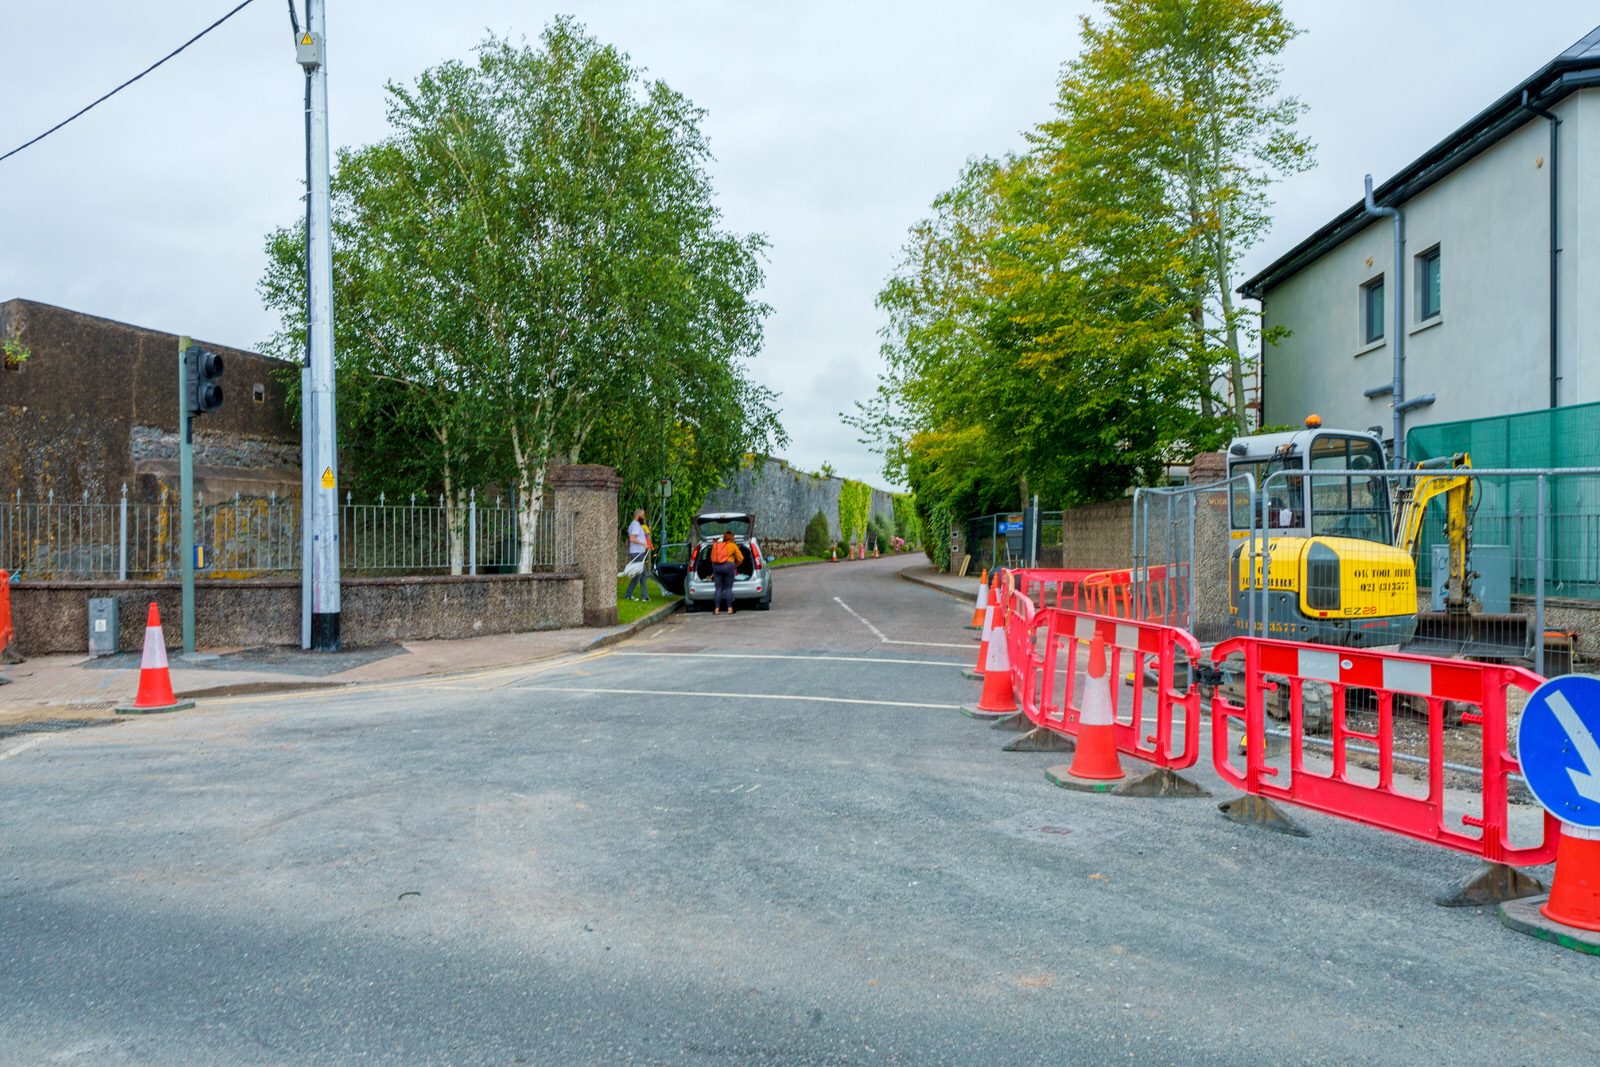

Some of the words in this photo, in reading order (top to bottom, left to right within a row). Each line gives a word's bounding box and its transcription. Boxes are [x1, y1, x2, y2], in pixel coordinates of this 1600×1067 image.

[1354, 569, 1368, 578] OK
[1372, 569, 1391, 578] TOOL
[1360, 582, 1375, 592] 021
[1343, 606, 1377, 616] EZ28
